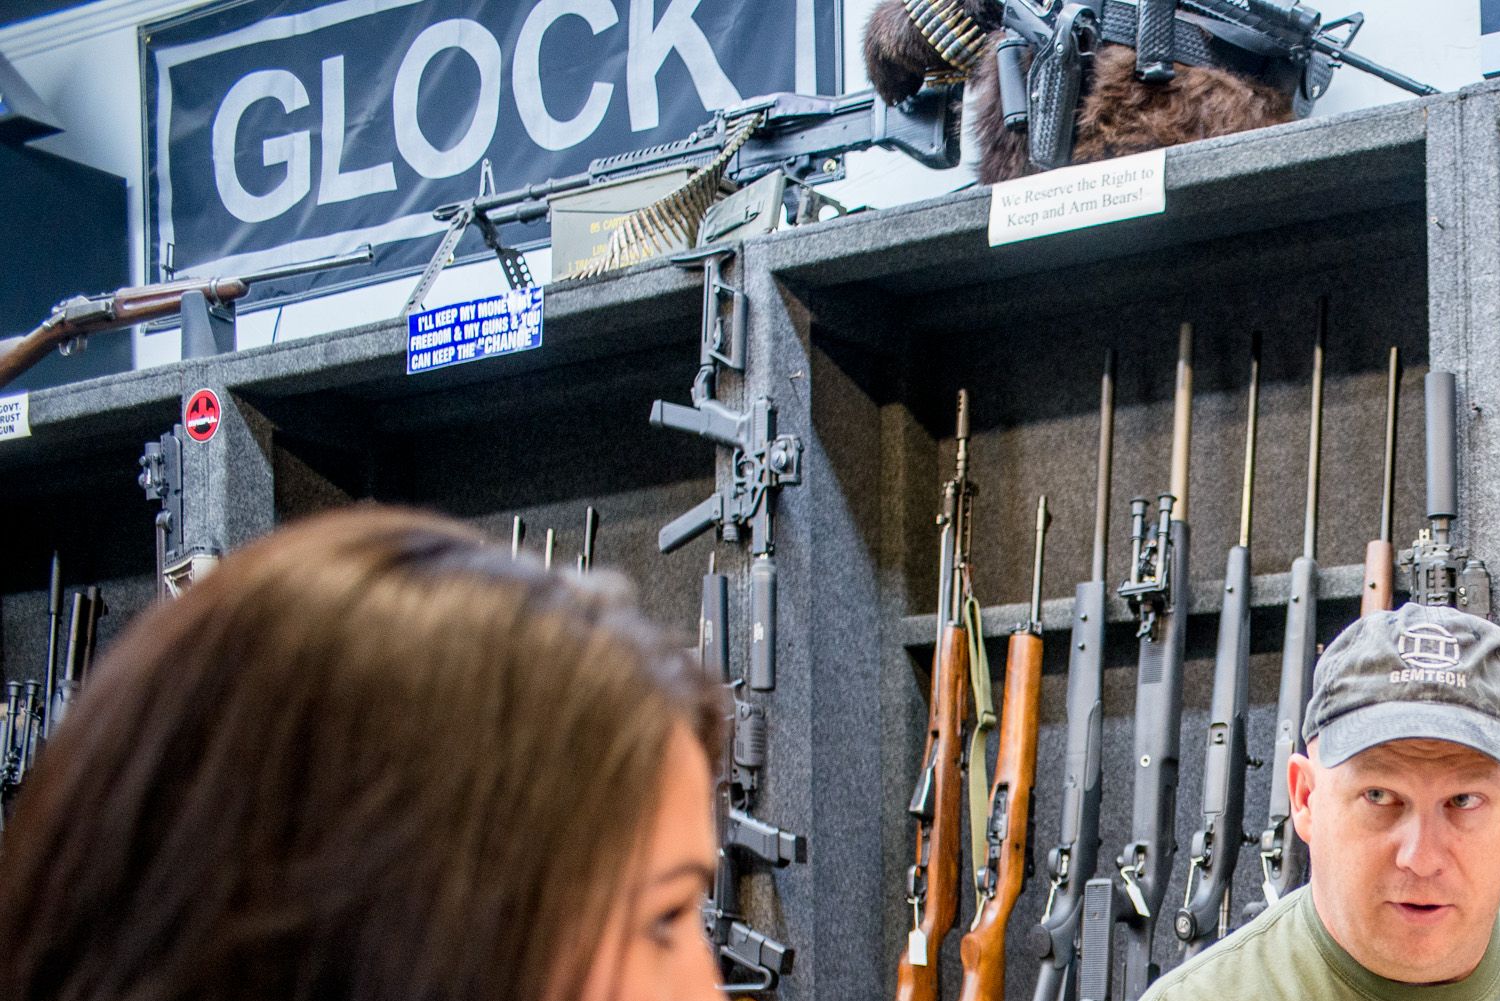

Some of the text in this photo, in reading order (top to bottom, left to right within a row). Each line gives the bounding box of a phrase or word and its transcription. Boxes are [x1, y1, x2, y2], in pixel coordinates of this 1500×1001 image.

[213, 0, 743, 224] GLOCK
[1002, 168, 1155, 209] We Reserve the Right to
[1007, 187, 1144, 228] Keep and Arm Bears!
[410, 310, 541, 352] FREEDOM & MY GUNS & YOU
[418, 316, 435, 332] I'LL
[435, 308, 458, 328] KEEP
[459, 303, 476, 322] MY
[411, 352, 431, 370] CAN
[432, 346, 456, 366] KEEP
[457, 342, 476, 360] THE
[1390, 669, 1466, 688] GEMTECH
